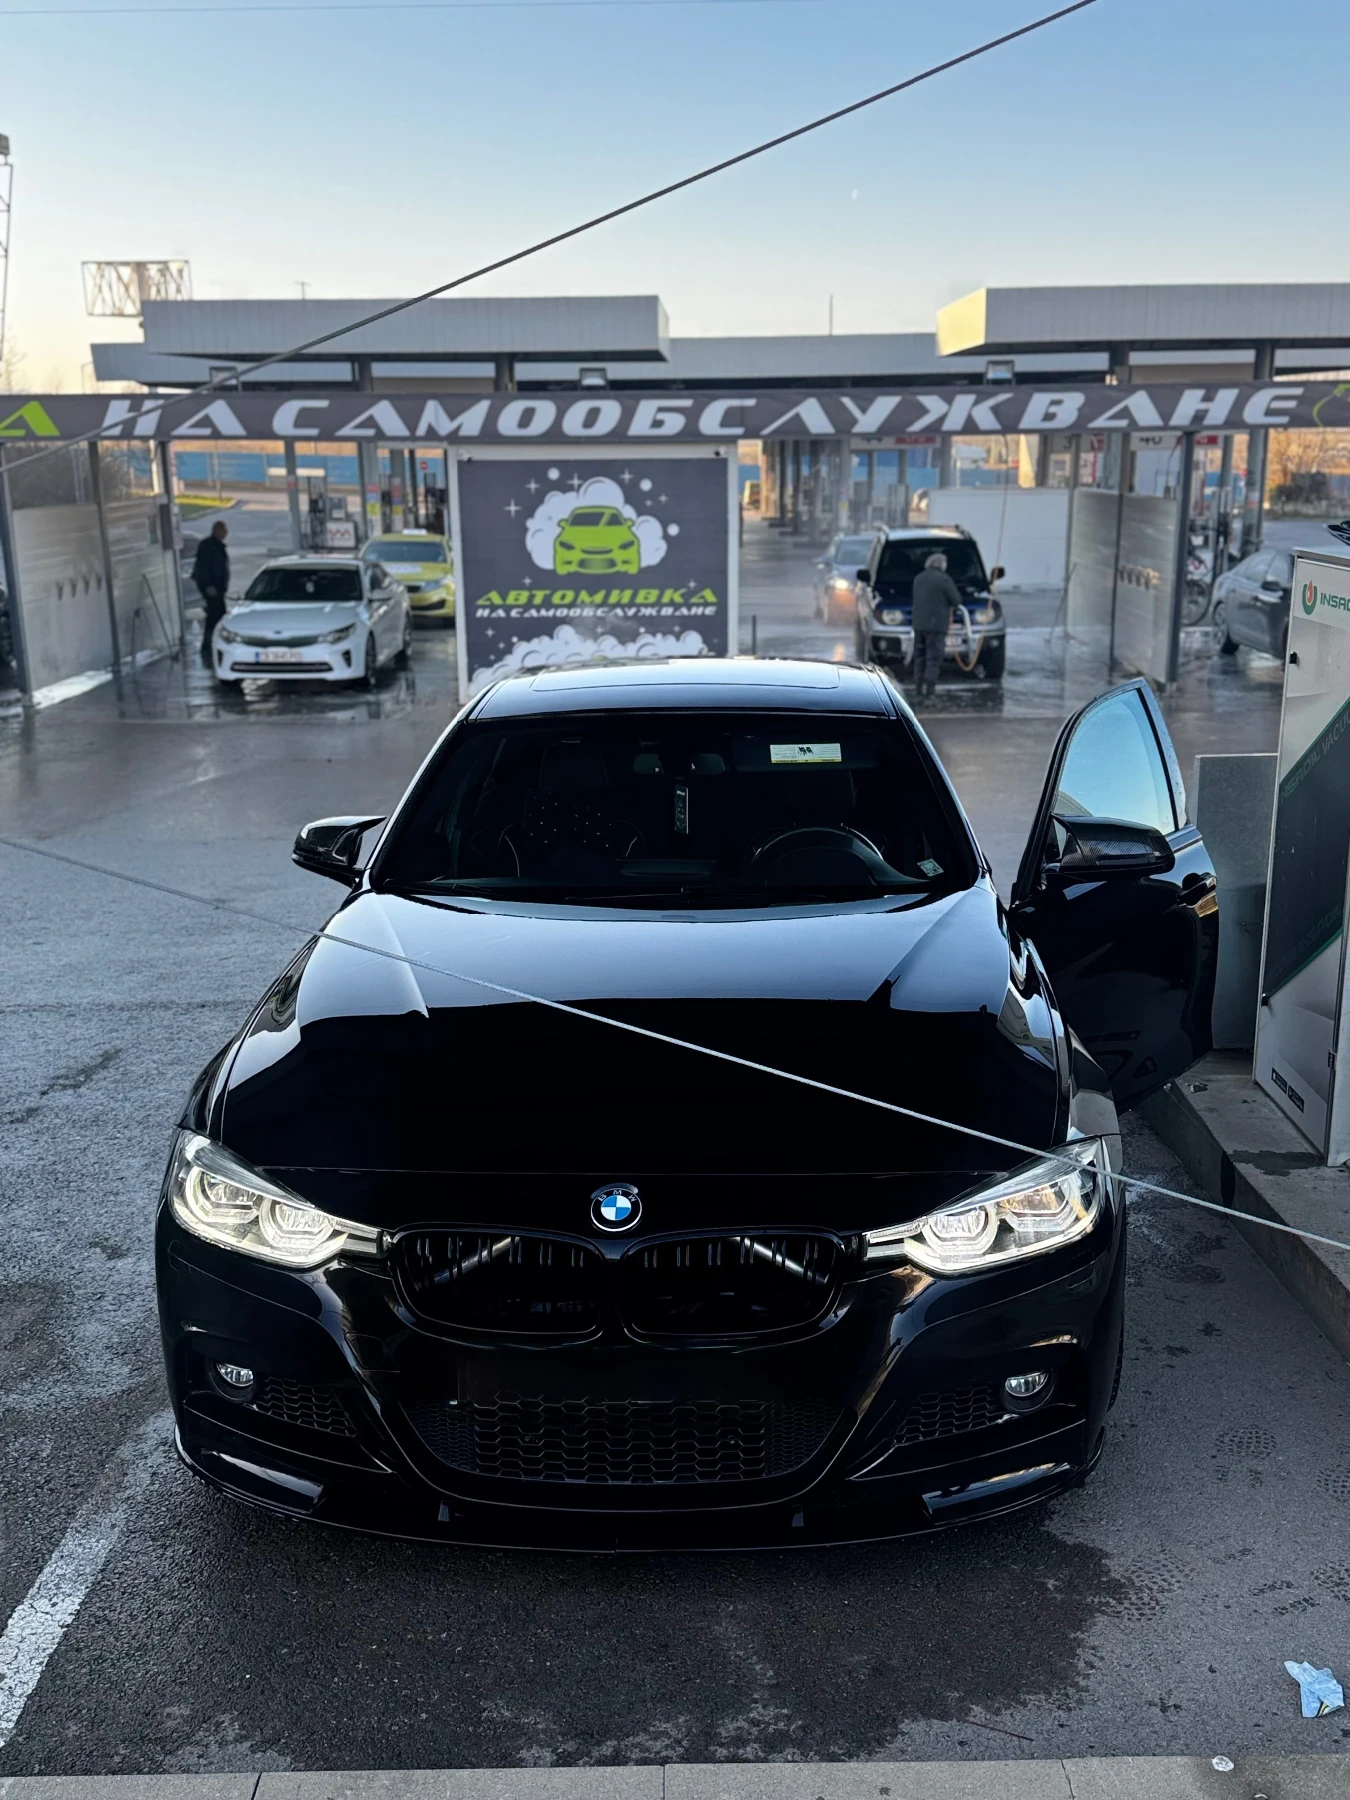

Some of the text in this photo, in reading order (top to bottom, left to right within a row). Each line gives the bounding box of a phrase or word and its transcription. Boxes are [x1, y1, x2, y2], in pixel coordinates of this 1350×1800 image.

[100, 399, 247, 437] НА
[272, 387, 1305, 438] САМООБСЛУЖВАНЕ
[475, 588, 719, 606] АВТОМИВКА
[597, 1189, 637, 1202] BMW
